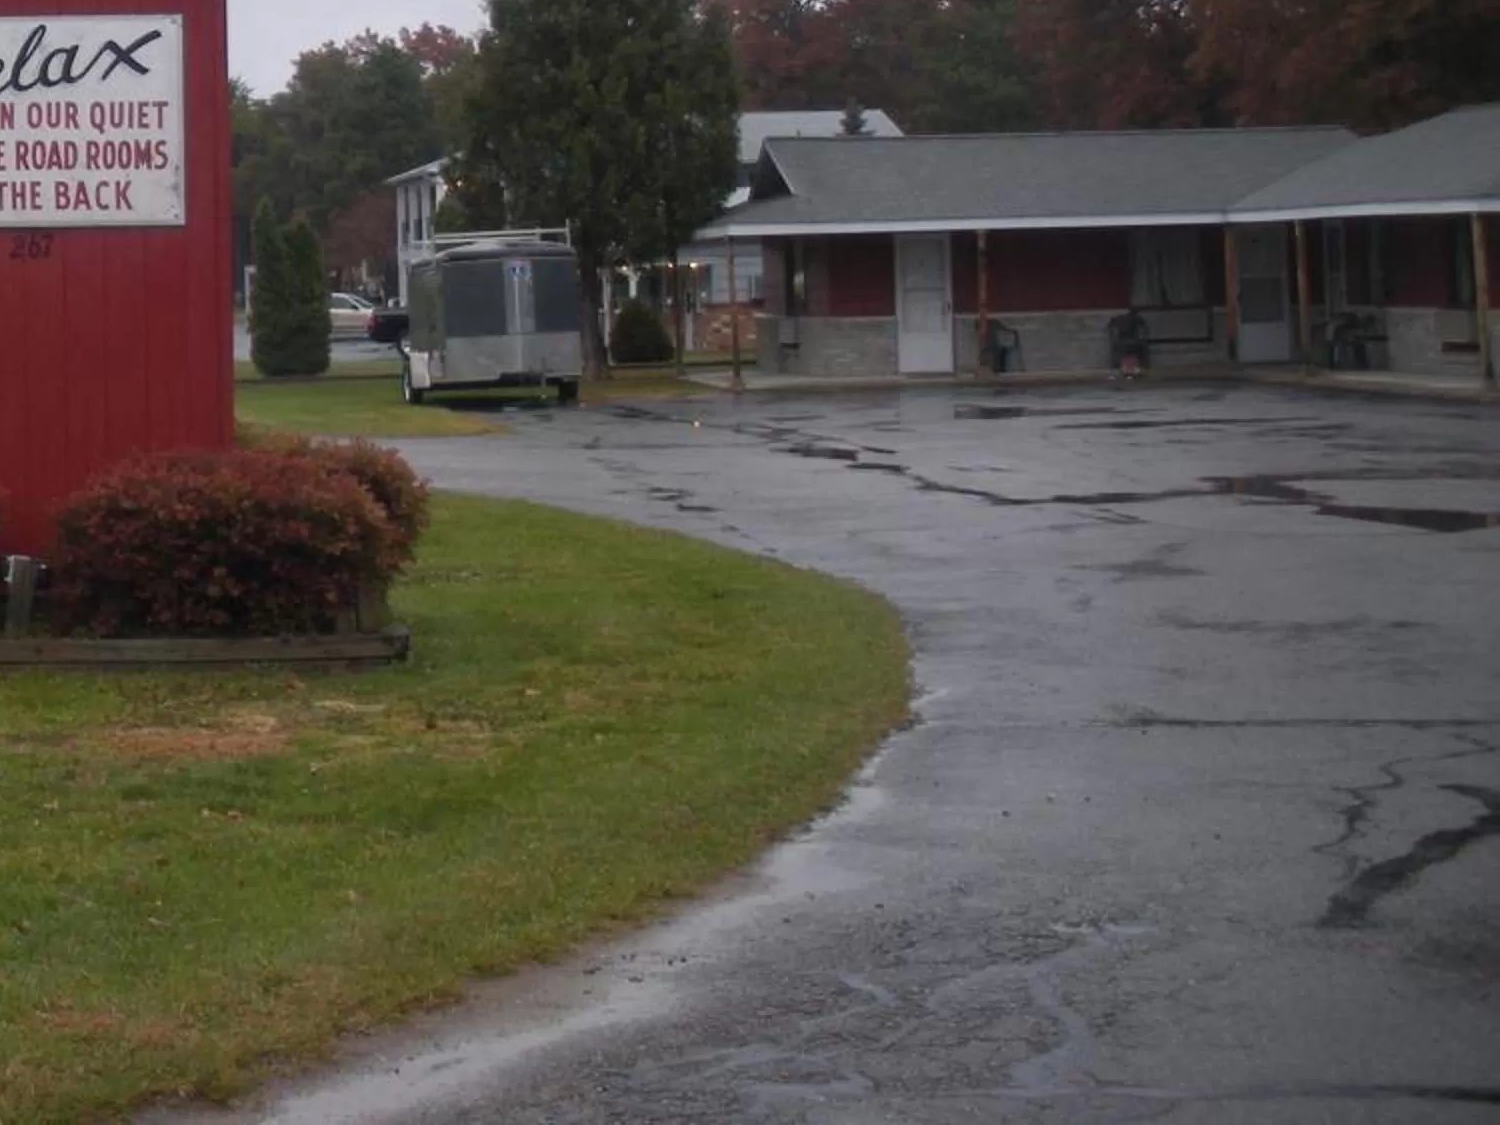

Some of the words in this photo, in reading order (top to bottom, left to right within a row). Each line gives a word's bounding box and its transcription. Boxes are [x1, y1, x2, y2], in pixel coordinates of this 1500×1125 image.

[27, 101, 80, 130] OUR
[89, 100, 169, 134] QUIET
[15, 140, 78, 171] ROAD
[86, 139, 169, 171] ROOMS
[55, 180, 134, 211] BACK
[9, 233, 54, 261] 267
